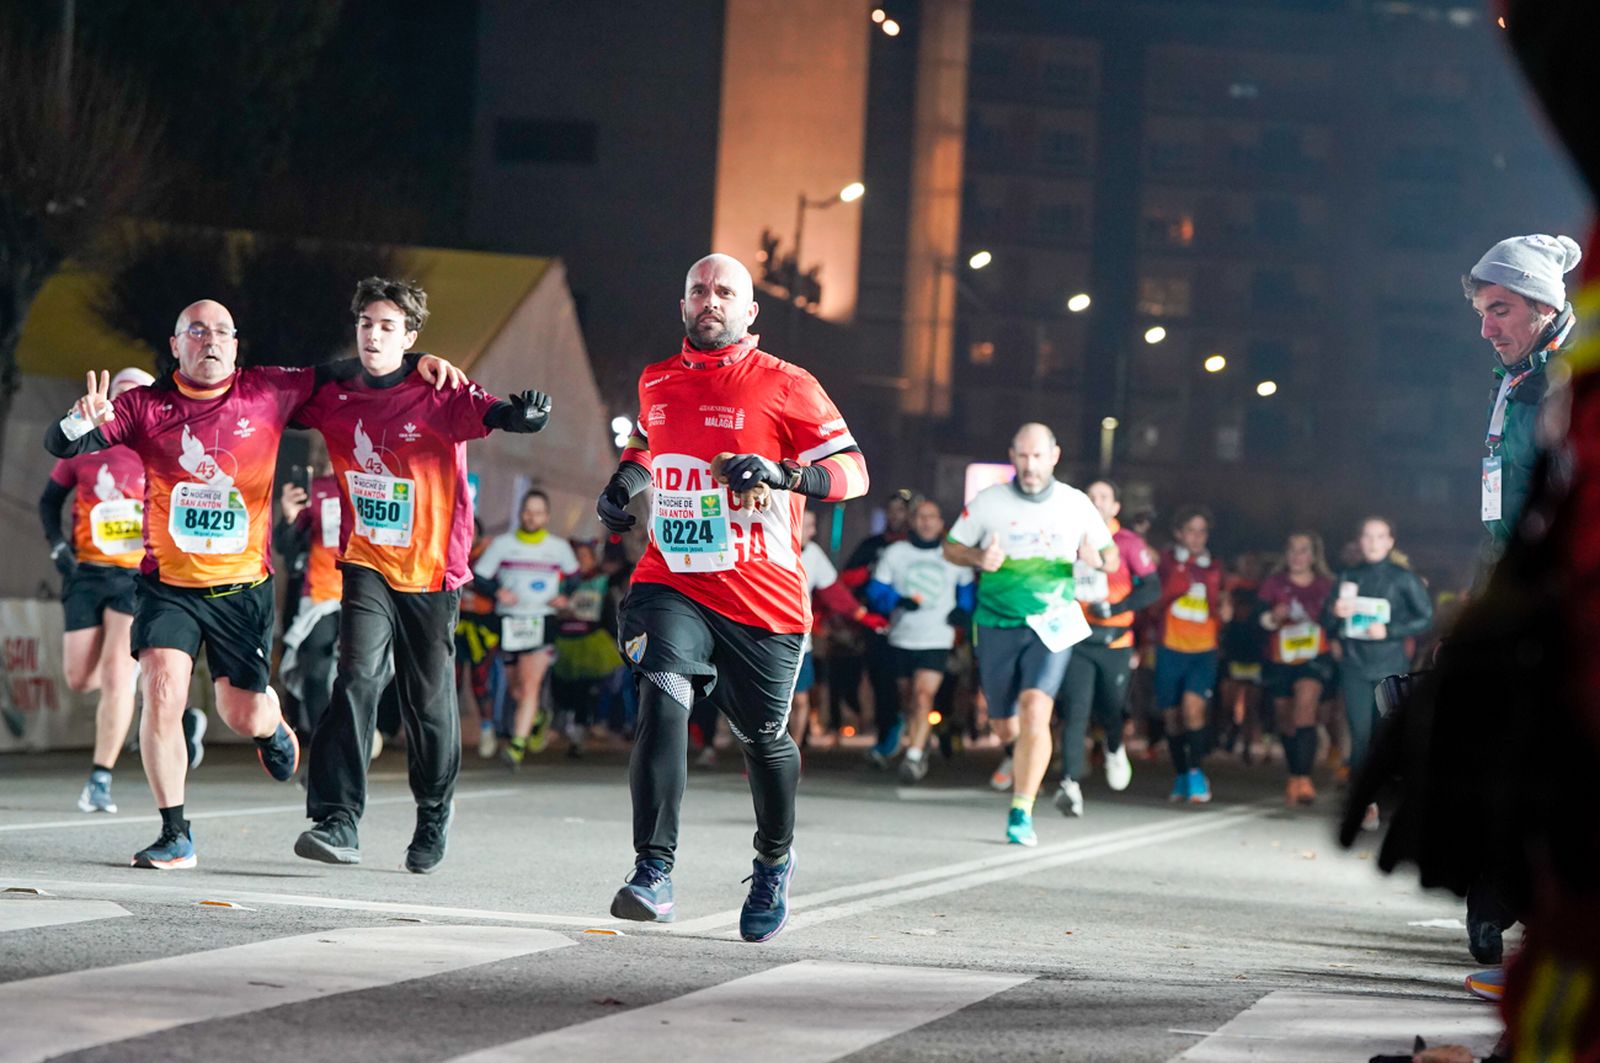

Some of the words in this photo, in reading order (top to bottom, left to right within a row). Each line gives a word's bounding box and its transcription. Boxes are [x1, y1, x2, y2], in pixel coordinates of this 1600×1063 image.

[705, 416, 733, 429] MÁLAGA
[196, 461, 216, 480] 43
[365, 458, 383, 475] 43
[213, 492, 222, 500] DE
[662, 499, 683, 507] NOCHE
[684, 500, 693, 508] DE
[357, 497, 400, 522] 8550
[185, 508, 235, 530] 8429
[663, 519, 714, 544] 8224
